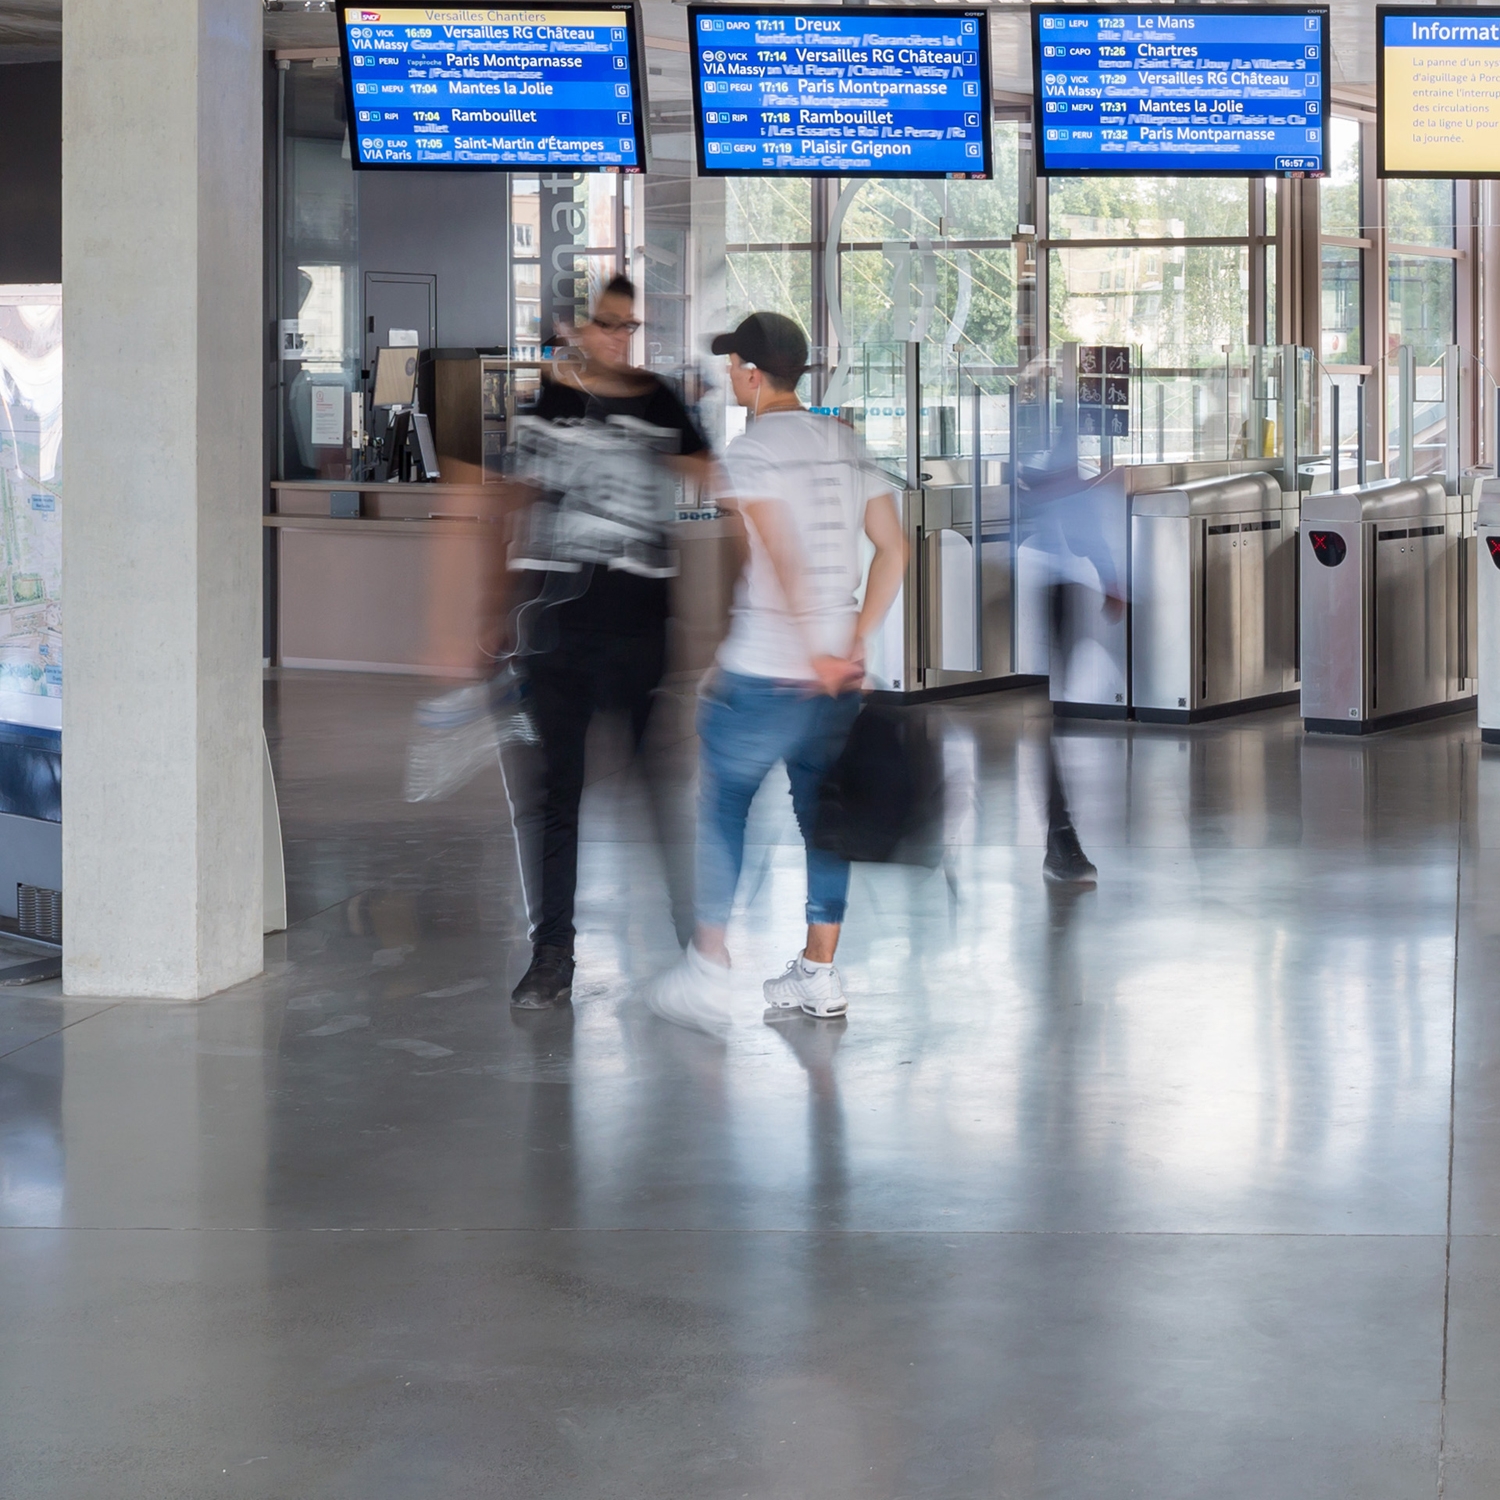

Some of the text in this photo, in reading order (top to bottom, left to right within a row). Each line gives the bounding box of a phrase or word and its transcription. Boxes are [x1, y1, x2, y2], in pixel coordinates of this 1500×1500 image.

[425, 10, 483, 21] Versailles
[487, 10, 546, 22] Chantiers
[1097, 18, 1125, 28] 17:23
[1137, 15, 1153, 28] Le
[1157, 15, 1195, 29] Mans
[404, 28, 432, 38] 16:59
[443, 25, 509, 38] Versailles
[513, 26, 533, 39] RG
[536, 26, 594, 39] Château
[614, 31, 622, 39] H
[726, 17, 973, 33] DAPO 17:11 Dreux G
[352, 39, 373, 49] VIA
[374, 39, 408, 52] Massy
[1098, 46, 1126, 56] 17:26
[1137, 43, 1198, 57] Chartres
[1308, 47, 1316, 57] G
[446, 53, 480, 66] Paris
[483, 54, 582, 70] Montparnasse
[617, 59, 624, 67] B
[727, 53, 748, 61] VICK
[757, 51, 787, 62] 17:14
[795, 48, 868, 63] Versailles
[872, 49, 895, 63] RG
[898, 49, 962, 64] Château
[1412, 58, 1424, 67] La
[1427, 59, 1457, 68] panne
[1460, 58, 1481, 67] d'un
[704, 63, 726, 75] VIA
[727, 63, 766, 78] Massy
[1099, 74, 1127, 84] 17:29
[1138, 71, 1204, 85] Versailles
[1207, 72, 1228, 85] RG
[1231, 71, 1289, 85] Château
[1412, 73, 1468, 84] d'aiguillage
[1470, 74, 1476, 82] à
[381, 81, 626, 95] MEPU 17:04 Mantes la Jolie G
[730, 83, 752, 91] PEGU
[758, 82, 789, 93] 17:16
[798, 78, 834, 93] Paris
[839, 79, 947, 97] Montparnasse
[1046, 86, 1066, 96] VIA
[1068, 86, 1102, 99] Massy
[1412, 89, 1454, 97] entraine
[1100, 102, 1127, 112] 17:31
[1139, 99, 1191, 112] Mantes
[1194, 99, 1207, 112] la
[1209, 99, 1243, 113] Jolie
[1308, 103, 1316, 112] G
[1412, 104, 1490, 112] des circulations
[413, 111, 440, 121] 17:04
[451, 108, 537, 122] Rambouillet
[761, 112, 791, 123] 17:18
[800, 109, 893, 124] Rambouillet
[968, 115, 976, 125] C
[1412, 119, 1425, 127] de
[1427, 119, 1437, 127] la
[1439, 119, 1463, 130] ligne
[1465, 119, 1473, 128] U
[1476, 121, 1498, 129] pour
[1072, 131, 1092, 139] PERU
[1101, 129, 1128, 139] 17:32
[1140, 127, 1173, 140] Paris
[1177, 127, 1275, 143] Montparnasse
[1412, 134, 1465, 144] la journée.
[415, 139, 443, 149] 17:05
[454, 136, 534, 150] Saint-Martin
[537, 136, 604, 153] d'Étampes
[733, 140, 977, 158] GEPU 17:19 Plaisir Grignon G
[363, 149, 384, 160] VIA
[385, 149, 412, 160] Paris
